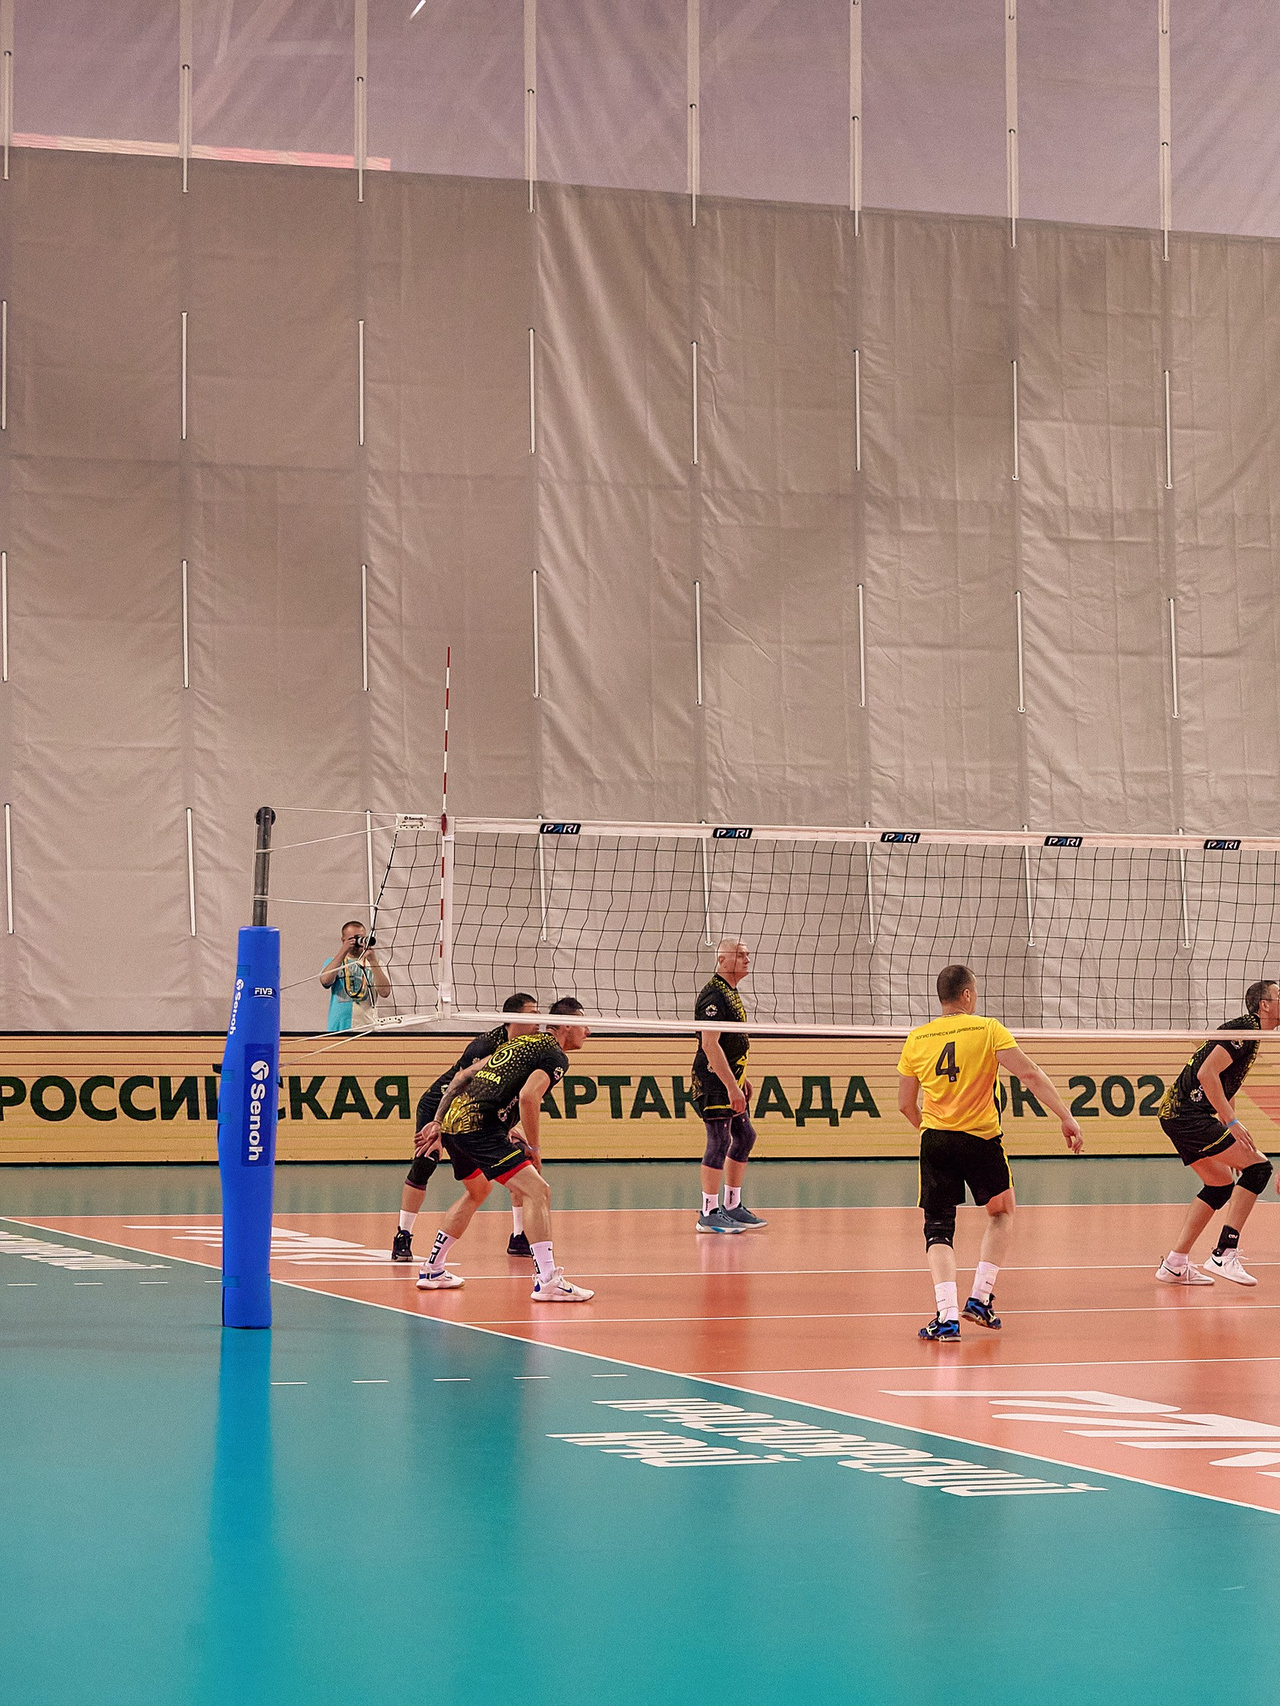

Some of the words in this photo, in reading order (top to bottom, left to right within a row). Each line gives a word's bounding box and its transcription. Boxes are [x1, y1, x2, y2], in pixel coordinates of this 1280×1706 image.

[543, 824, 580, 835] PARI
[715, 829, 751, 839] PARI
[883, 833, 918, 843] PARI
[1048, 837, 1081, 847] PARI
[1206, 840, 1240, 851] PARI
[934, 1041, 961, 1083] 4
[249, 1082, 267, 1162] Senoh
